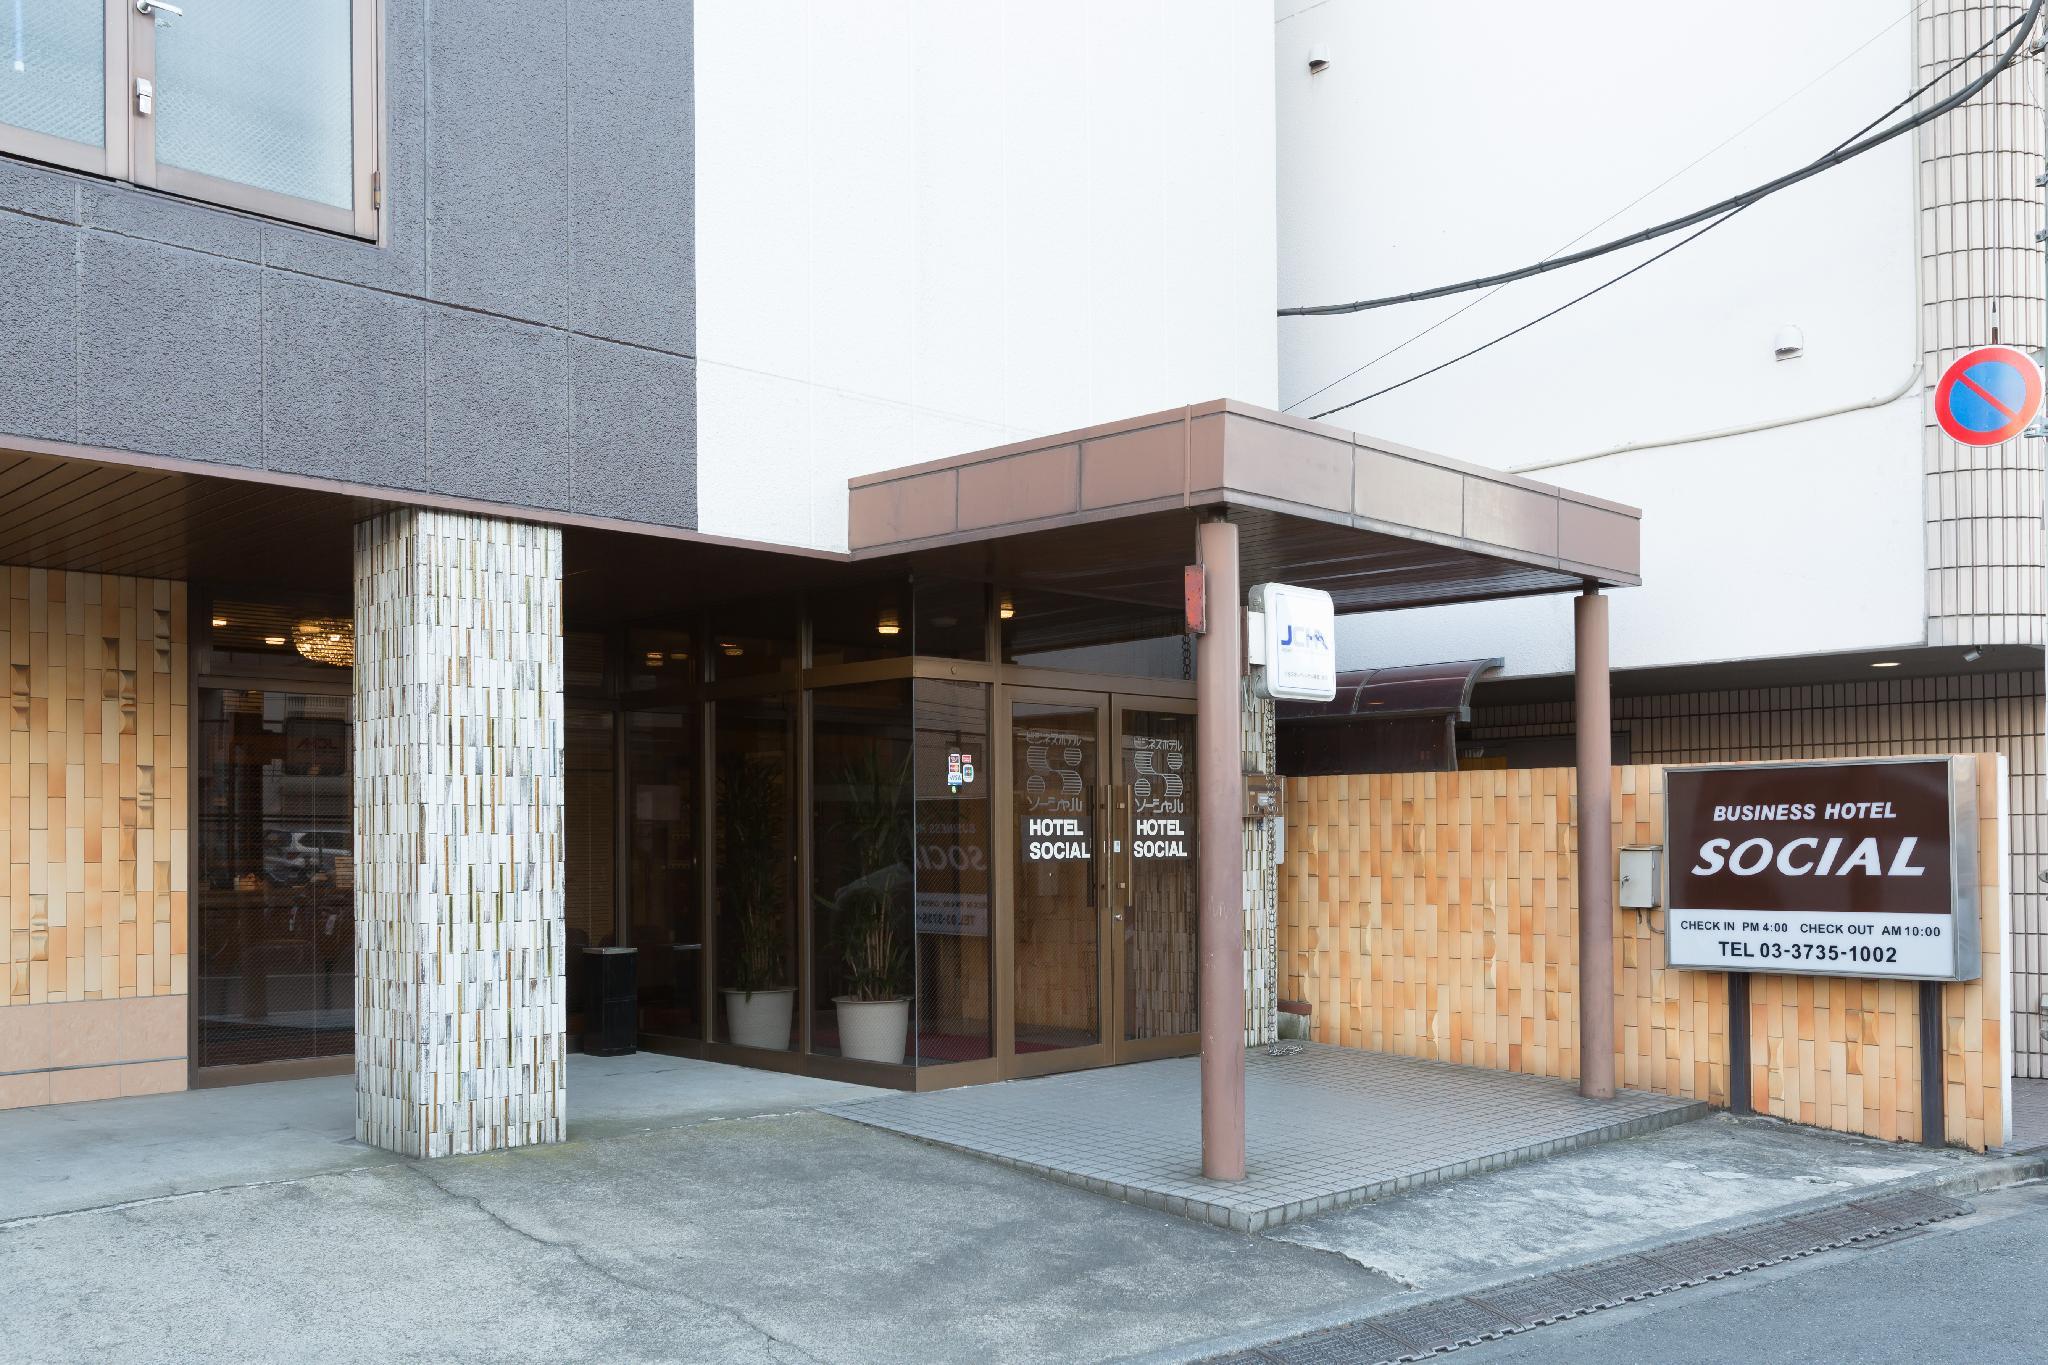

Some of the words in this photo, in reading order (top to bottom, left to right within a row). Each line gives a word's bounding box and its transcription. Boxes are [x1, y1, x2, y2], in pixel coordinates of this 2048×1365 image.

[1027, 796, 1083, 812] ソーシャル
[1134, 798, 1184, 813] ソーシャル
[1713, 803, 1817, 821] BUSINESS
[1824, 801, 1897, 820] HOTEL
[1029, 819, 1084, 836] HOTEL
[1136, 819, 1185, 836] HOTEL
[1029, 841, 1091, 859] SOCIAL
[1133, 840, 1188, 858] SOCIAL
[1690, 836, 1926, 876] SOCIAL
[1680, 920, 1720, 931] CHECK
[1723, 921, 1735, 931] IN
[1742, 922, 1759, 932] PM
[1762, 922, 1788, 933] 4:00
[1800, 923, 1844, 935] CHECK
[1847, 924, 1874, 935] OUT
[1881, 926, 1902, 936] AM
[1904, 926, 1941, 937] 10:00
[1718, 941, 1754, 958] TEL
[1760, 942, 1897, 963] 03-3735-1002
